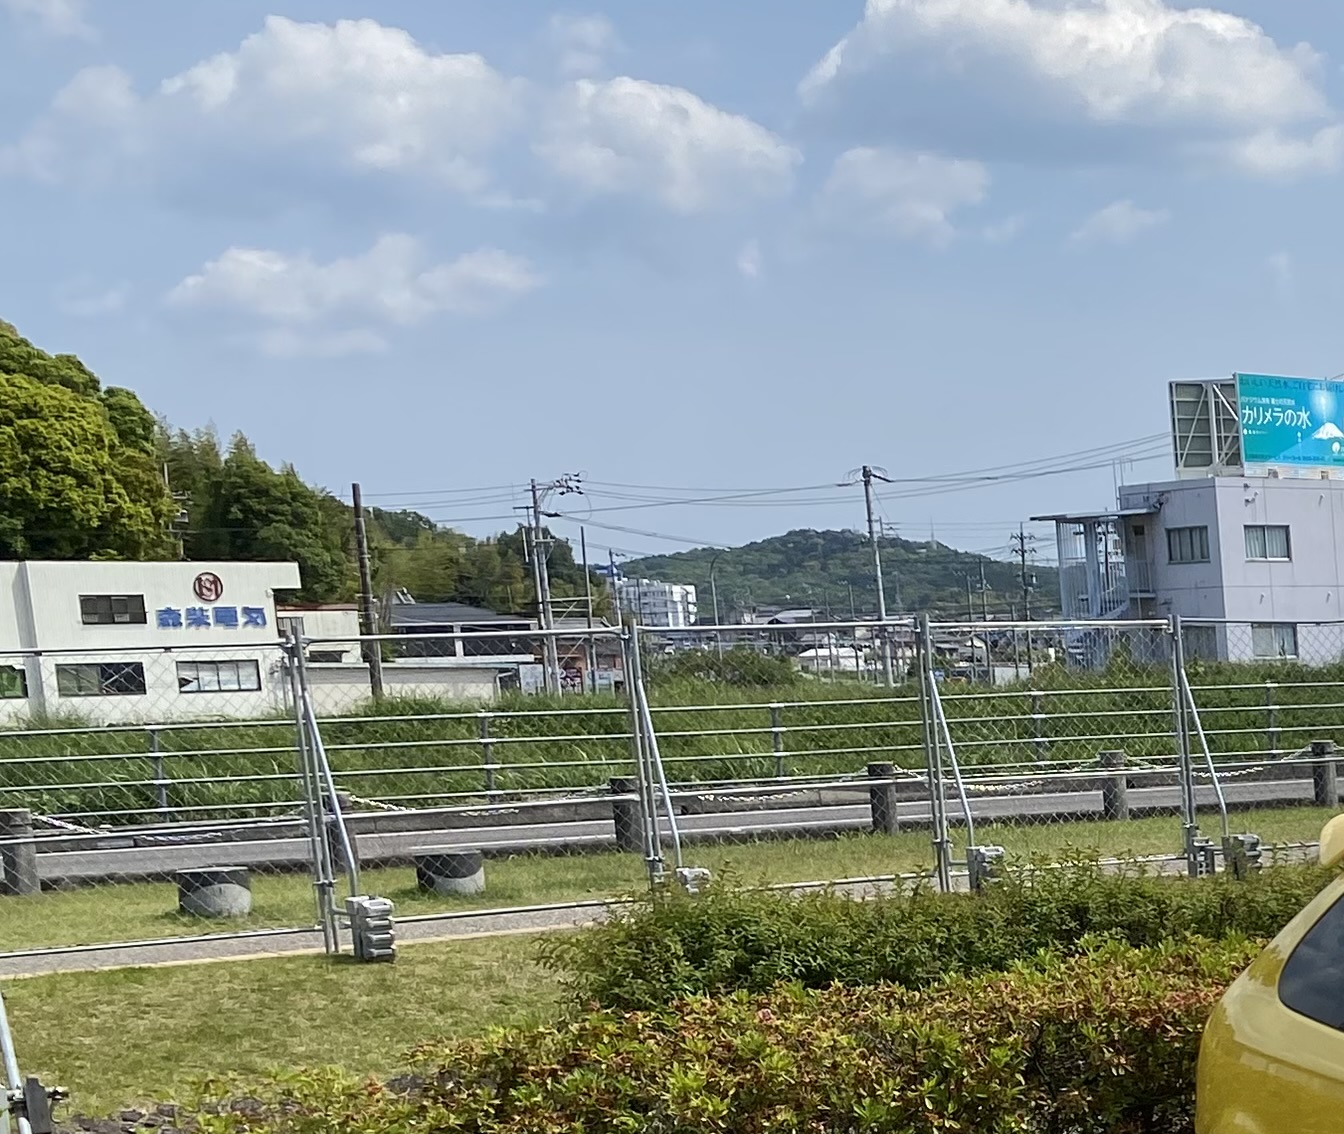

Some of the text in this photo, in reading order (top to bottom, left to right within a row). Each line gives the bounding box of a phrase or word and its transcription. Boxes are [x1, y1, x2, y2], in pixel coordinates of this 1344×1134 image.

[1242, 405, 1312, 430] カリメラの水
